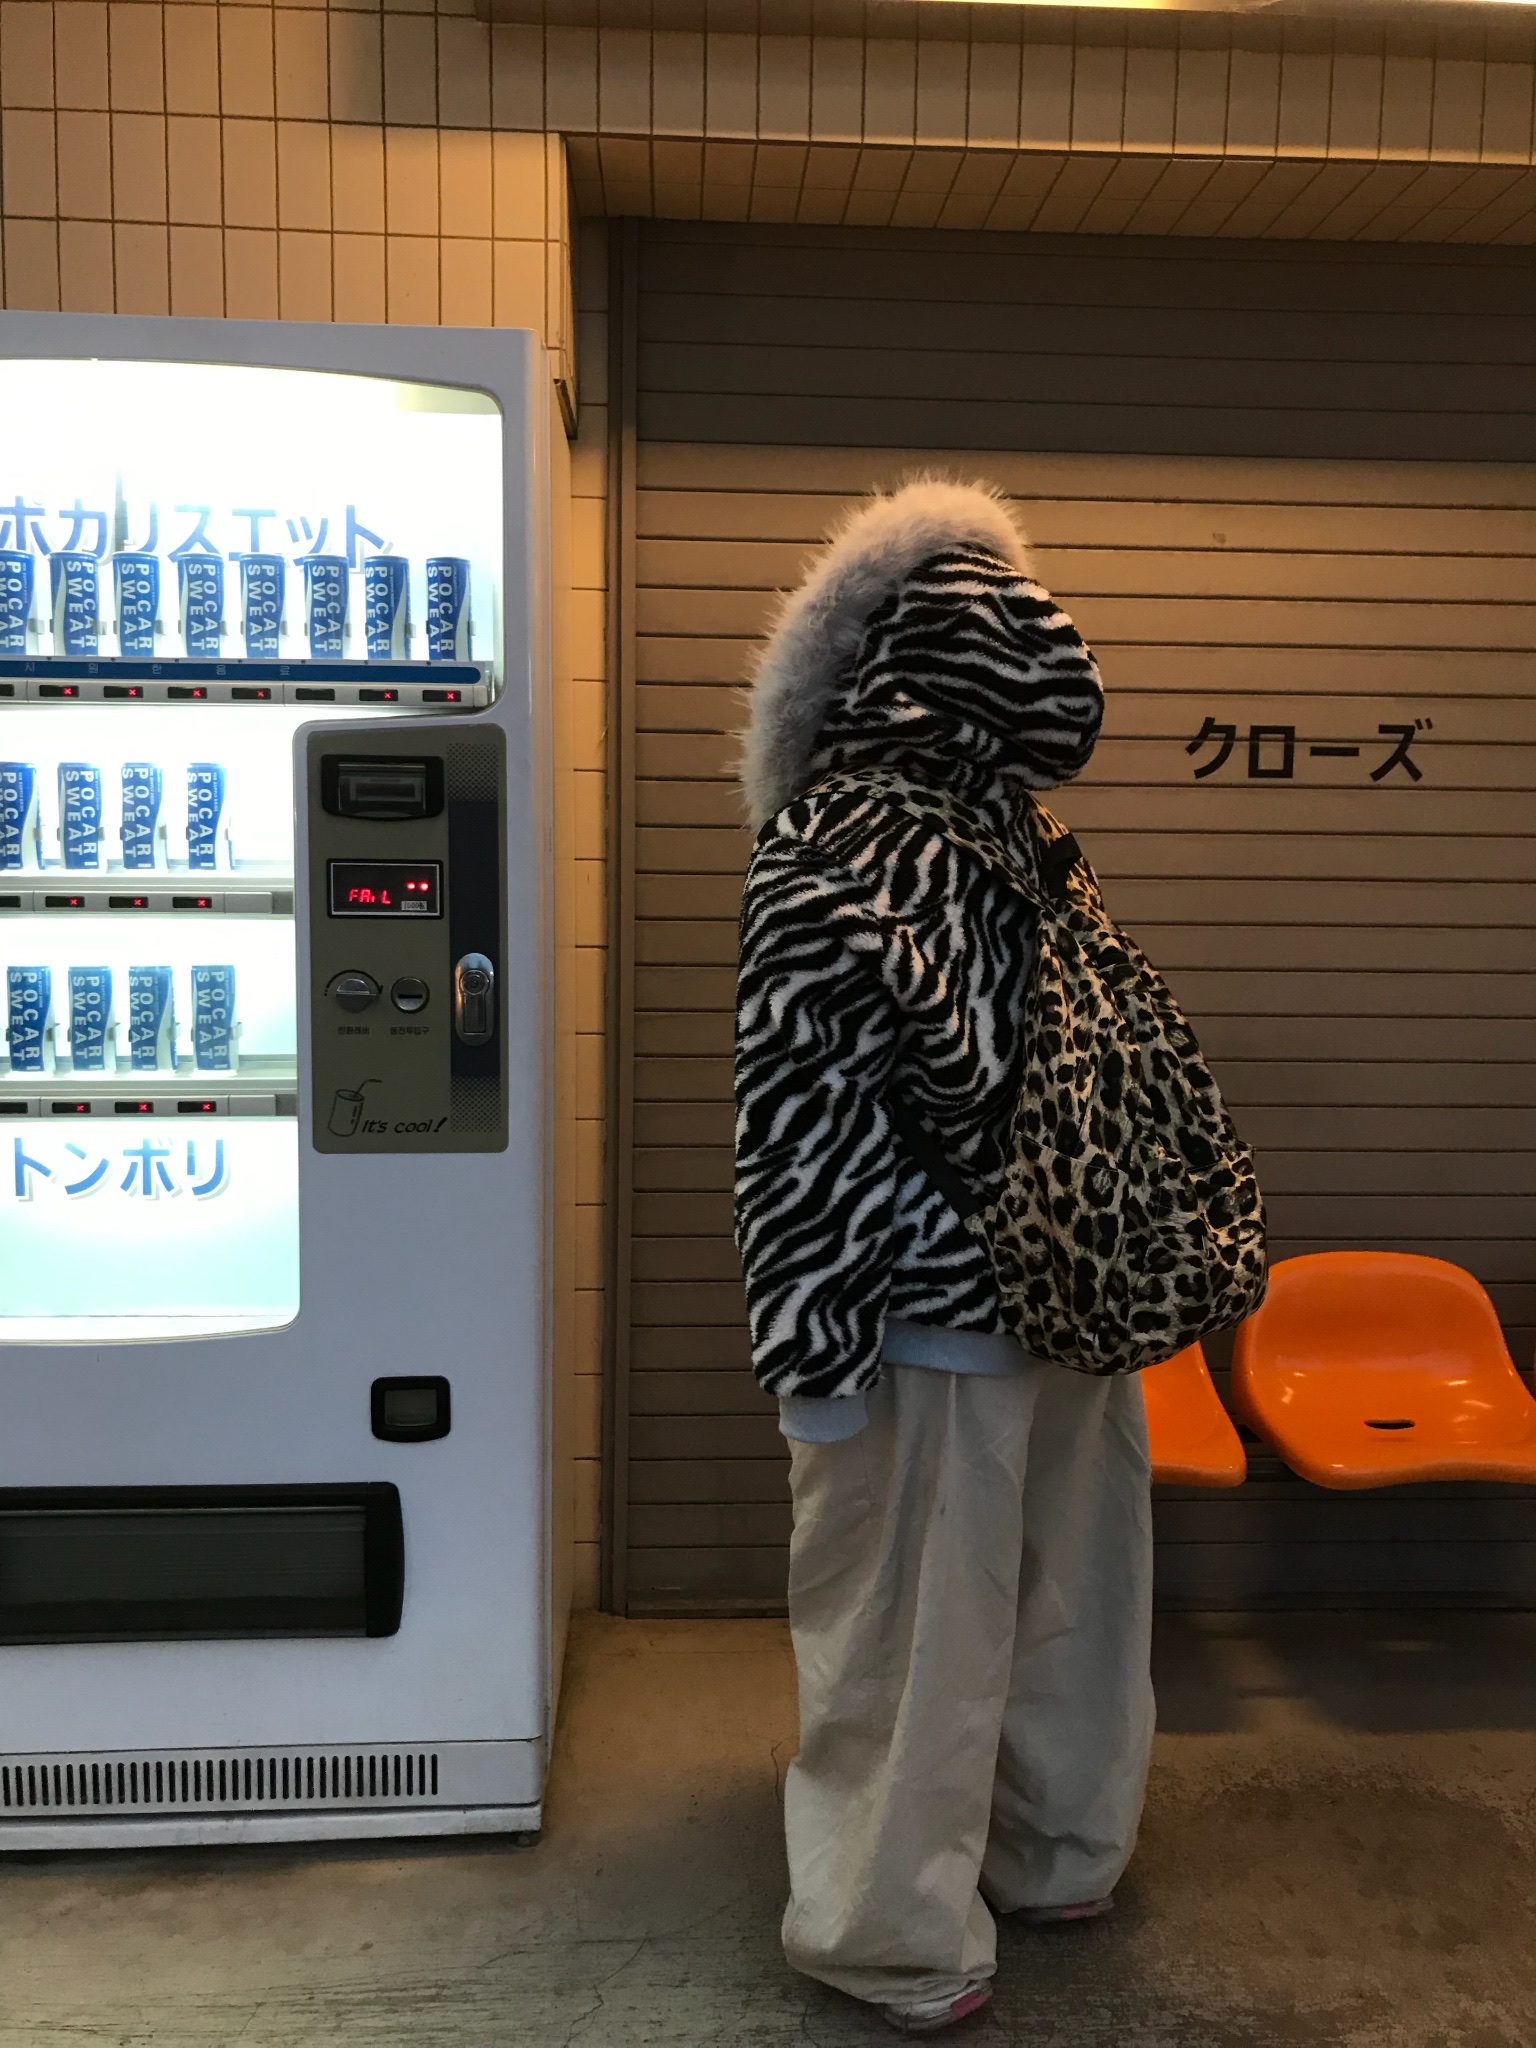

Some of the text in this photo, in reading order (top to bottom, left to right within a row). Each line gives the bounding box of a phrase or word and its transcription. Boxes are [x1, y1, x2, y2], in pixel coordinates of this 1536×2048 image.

[6, 561, 25, 647] POCAR
[67, 561, 85, 648] SWEAT
[82, 562, 97, 656] POCAR
[121, 563, 138, 650] SWEAT
[135, 563, 153, 650] POCAR
[189, 563, 205, 650] SWEAT
[203, 563, 219, 657] POCAR
[247, 564, 263, 652] SWEAT
[262, 564, 277, 658] POCAR
[312, 566, 327, 652] SWEAT
[325, 566, 342, 651] POCAR
[365, 567, 377, 653] SWEAT
[375, 567, 390, 652] POCAR
[427, 566, 440, 653] SWEAT
[437, 566, 454, 660] POCAR
[1185, 716, 1433, 782] クローズ
[2, 772, 20, 867] POCARI
[66, 770, 82, 855] SWEAT
[80, 770, 97, 866] POCARI
[121, 768, 136, 857] SWEAT
[135, 768, 151, 867] POCARI
[187, 772, 200, 856] SWEAT
[198, 772, 214, 867] POCARI
[10, 972, 25, 1060] SWEAT
[23, 972, 41, 1070] POCARI
[73, 976, 88, 1058] SWEAT
[86, 976, 102, 1070] POCARI
[130, 976, 141, 1058] SWEAT
[139, 976, 156, 1070] POCARI
[197, 971, 213, 1058] SWEAT
[211, 971, 228, 1069] POCARI
[362, 1119, 388, 1133] It's
